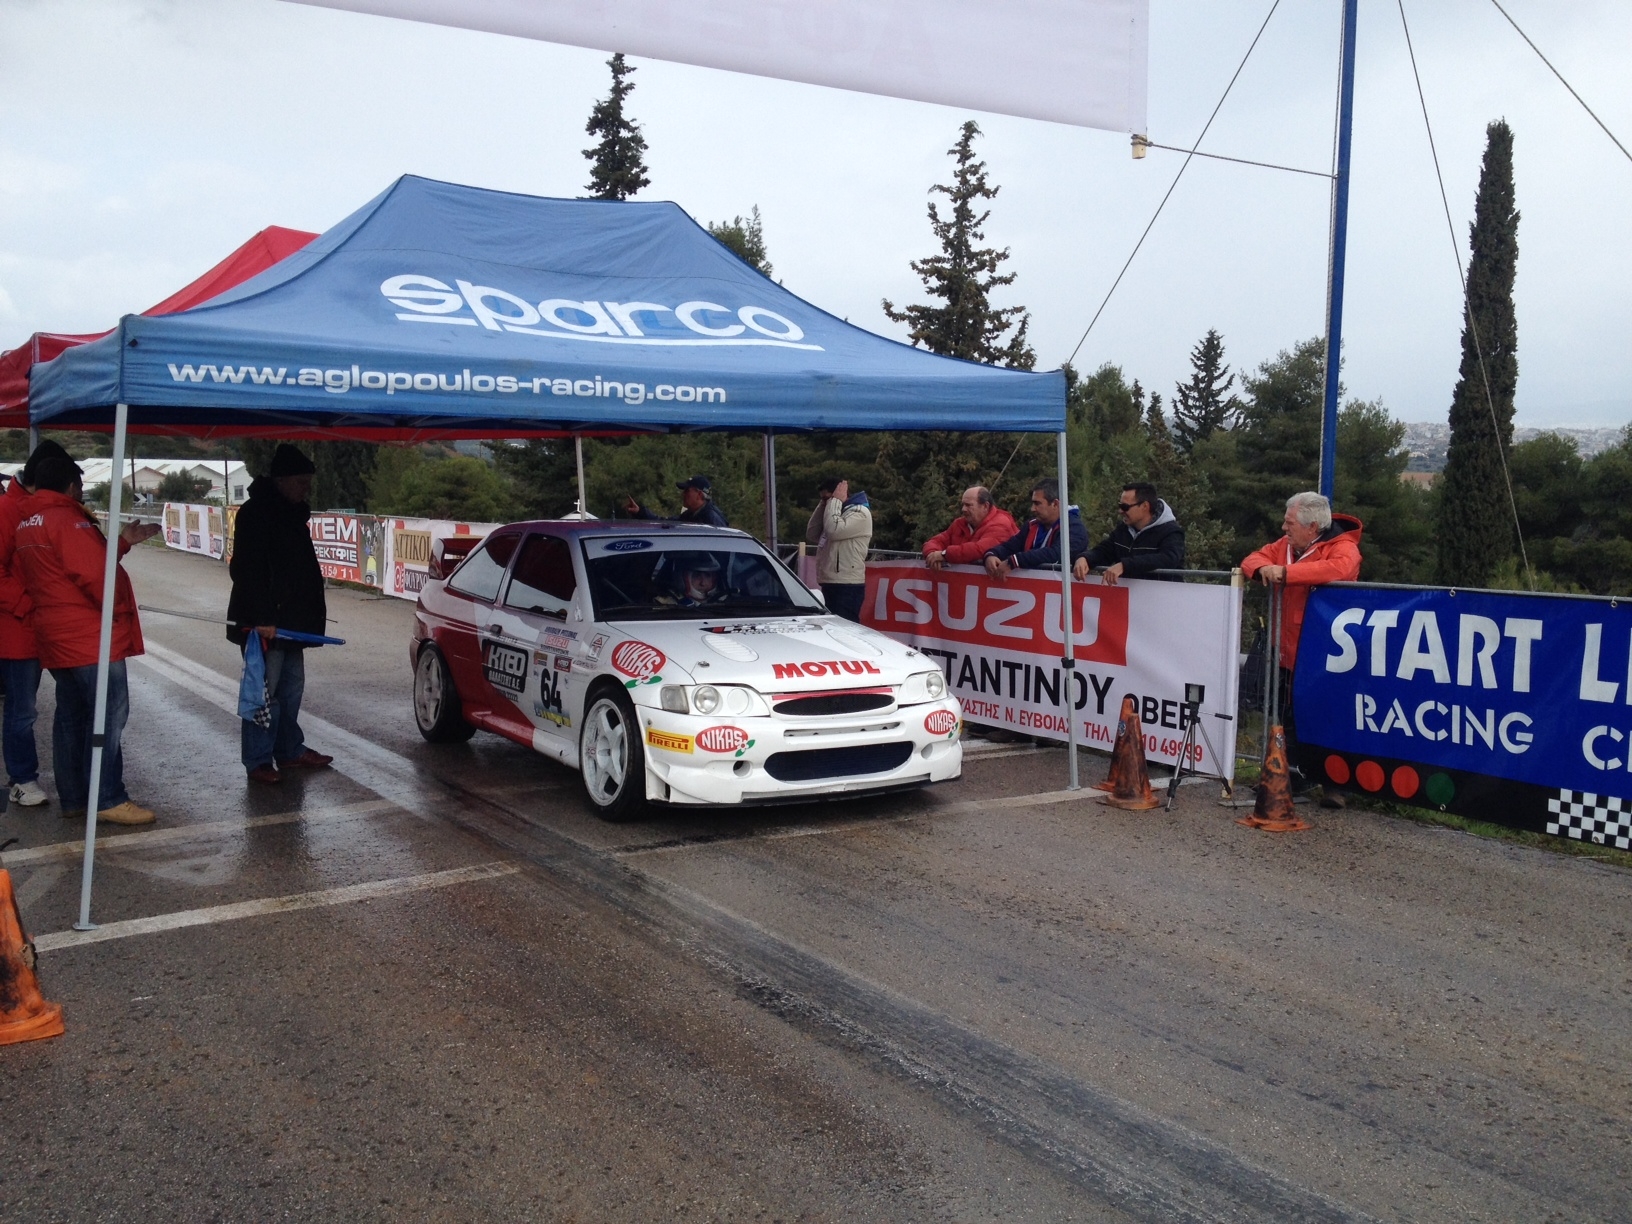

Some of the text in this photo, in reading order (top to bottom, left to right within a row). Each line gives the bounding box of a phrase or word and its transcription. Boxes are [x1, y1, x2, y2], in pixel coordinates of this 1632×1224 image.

[380, 274, 805, 342] sparco
[167, 362, 727, 405] www.aglopoulos-racing.com
[614, 541, 643, 550] Ford
[874, 577, 1101, 647] ISUZU
[545, 635, 570, 649] ISUZU
[614, 643, 661, 676] NIKAS
[1325, 607, 1543, 693] START
[540, 668, 562, 714] 64
[771, 660, 881, 679] MOTUL
[908, 644, 1115, 715] ΤΑΝΤΙΝΟΥ
[649, 732, 690, 750] PIRELLI
[701, 726, 743, 750] NIKAS
[929, 712, 954, 731] NIKAS
[956, 696, 999, 720] ΥΑΣΤΗΣ
[1005, 706, 1016, 723] Ν.
[1084, 721, 1113, 744] ΤΗΛ.
[1356, 693, 1632, 774] RACING C
